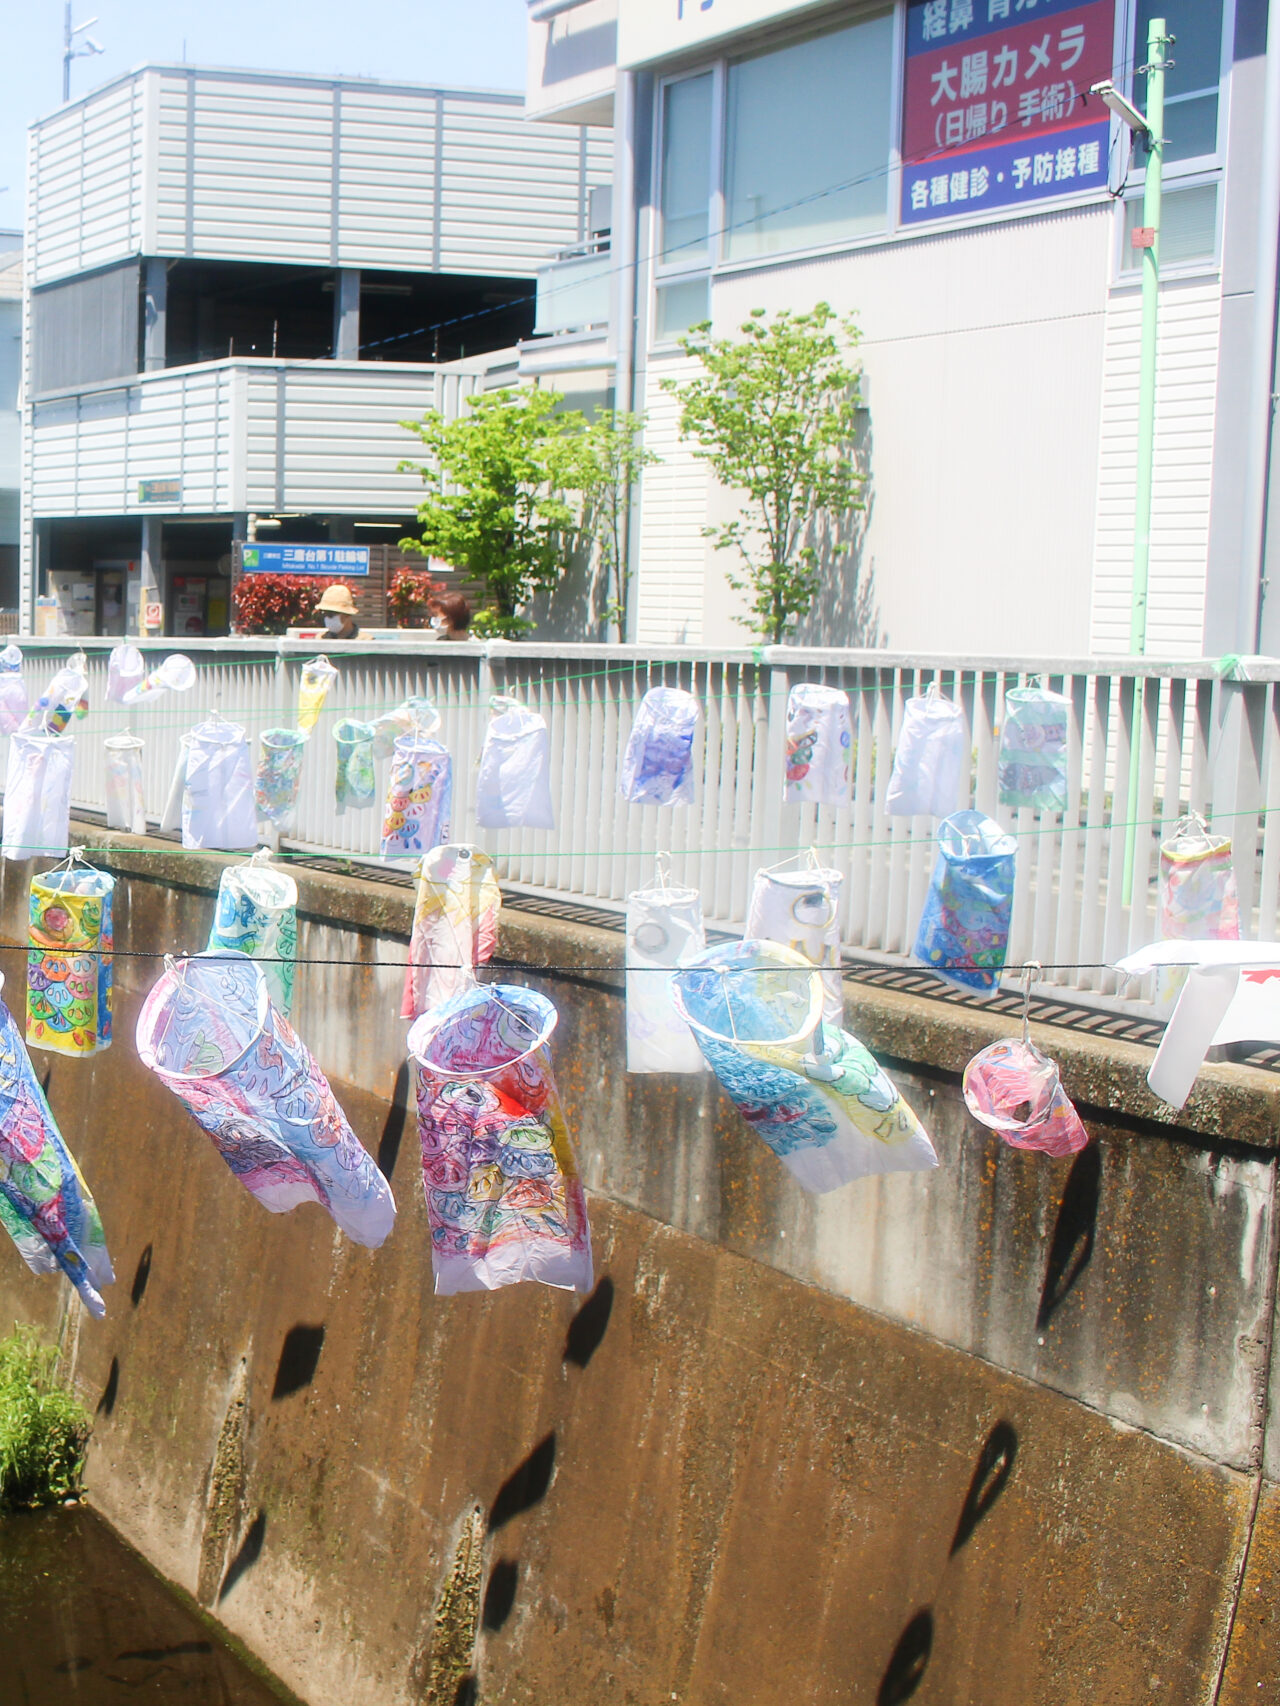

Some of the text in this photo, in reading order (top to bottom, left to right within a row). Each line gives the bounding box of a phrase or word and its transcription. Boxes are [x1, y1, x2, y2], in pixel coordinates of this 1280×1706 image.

[930, 24, 1086, 106] 大腸カメラ
[910, 141, 1100, 210] 各種健診・予防接種
